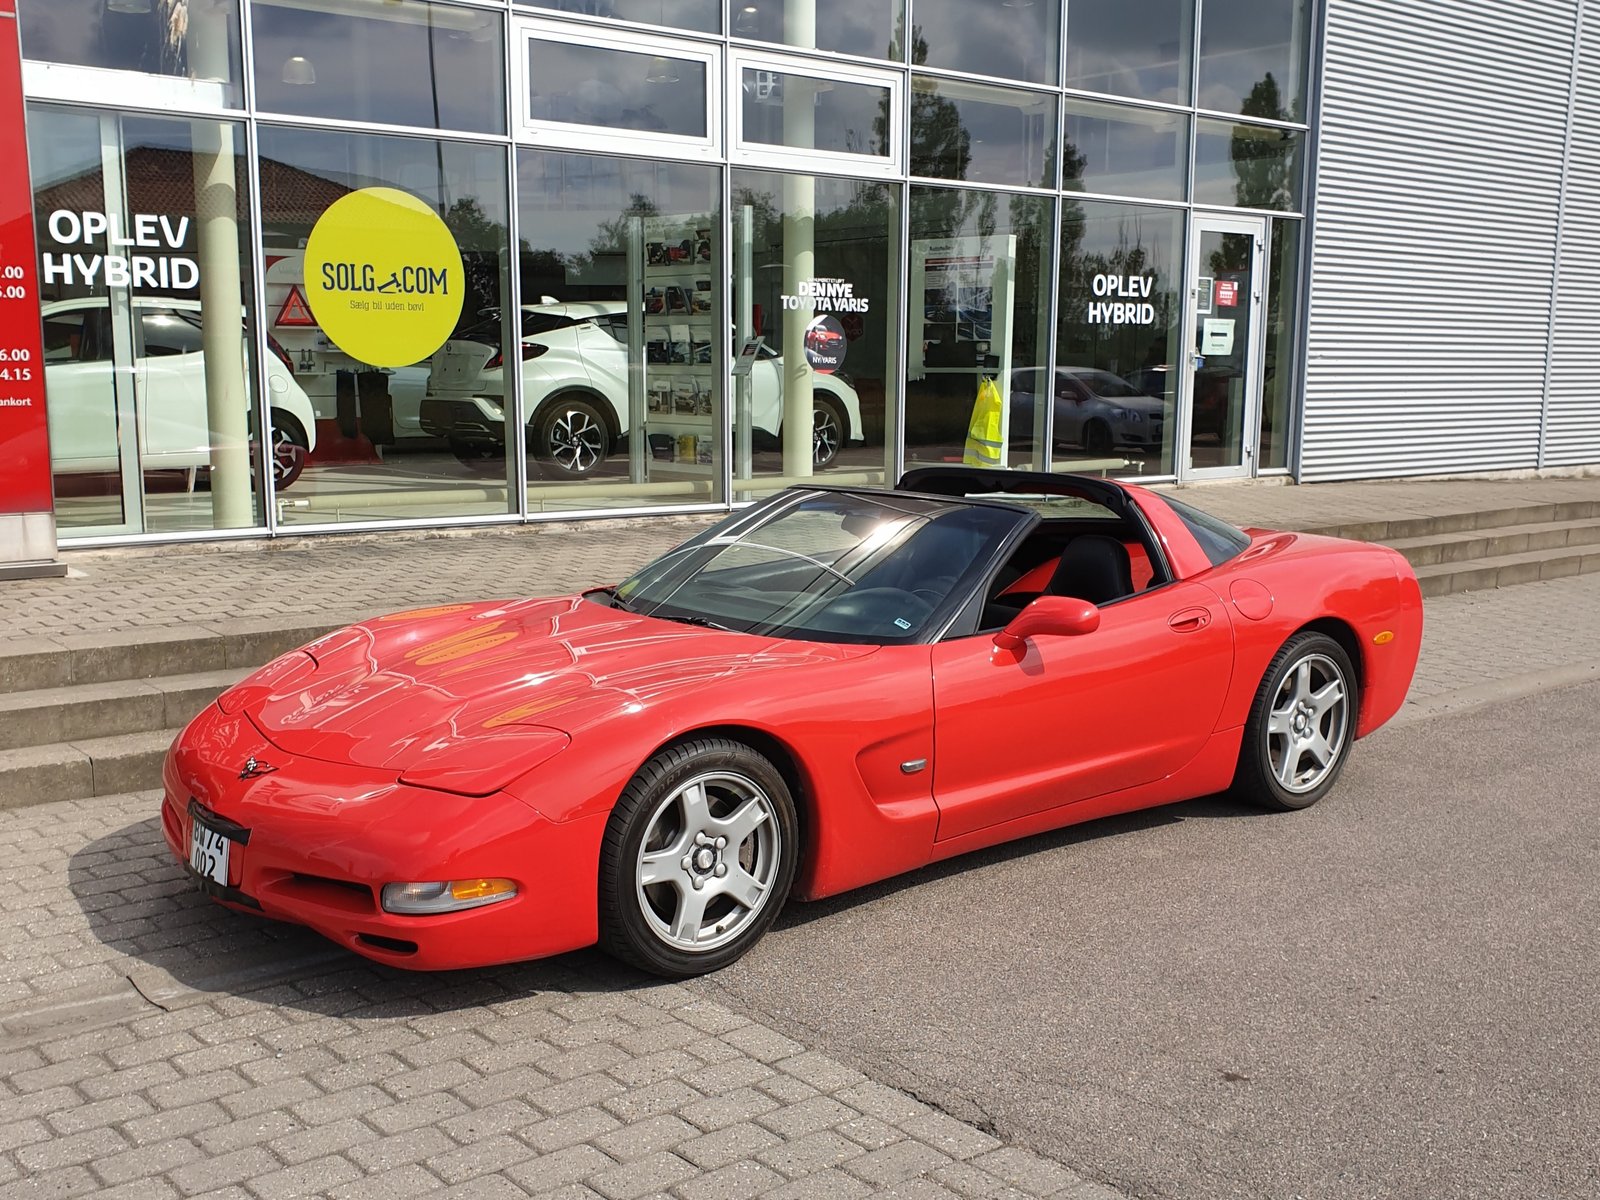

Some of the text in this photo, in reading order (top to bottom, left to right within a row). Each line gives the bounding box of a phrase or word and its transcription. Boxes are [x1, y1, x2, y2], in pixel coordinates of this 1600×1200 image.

[48, 209, 189, 248] OPLEV
[0, 266, 24, 279] .00
[43, 252, 199, 289] HYBRID
[0, 286, 26, 298] .00
[799, 281, 853, 298] DEN NYE
[1093, 273, 1153, 297] OPLEV
[385, 301, 405, 311] uden
[781, 295, 869, 313] TOYOTA YARIS
[1088, 302, 1154, 325] HYBRID
